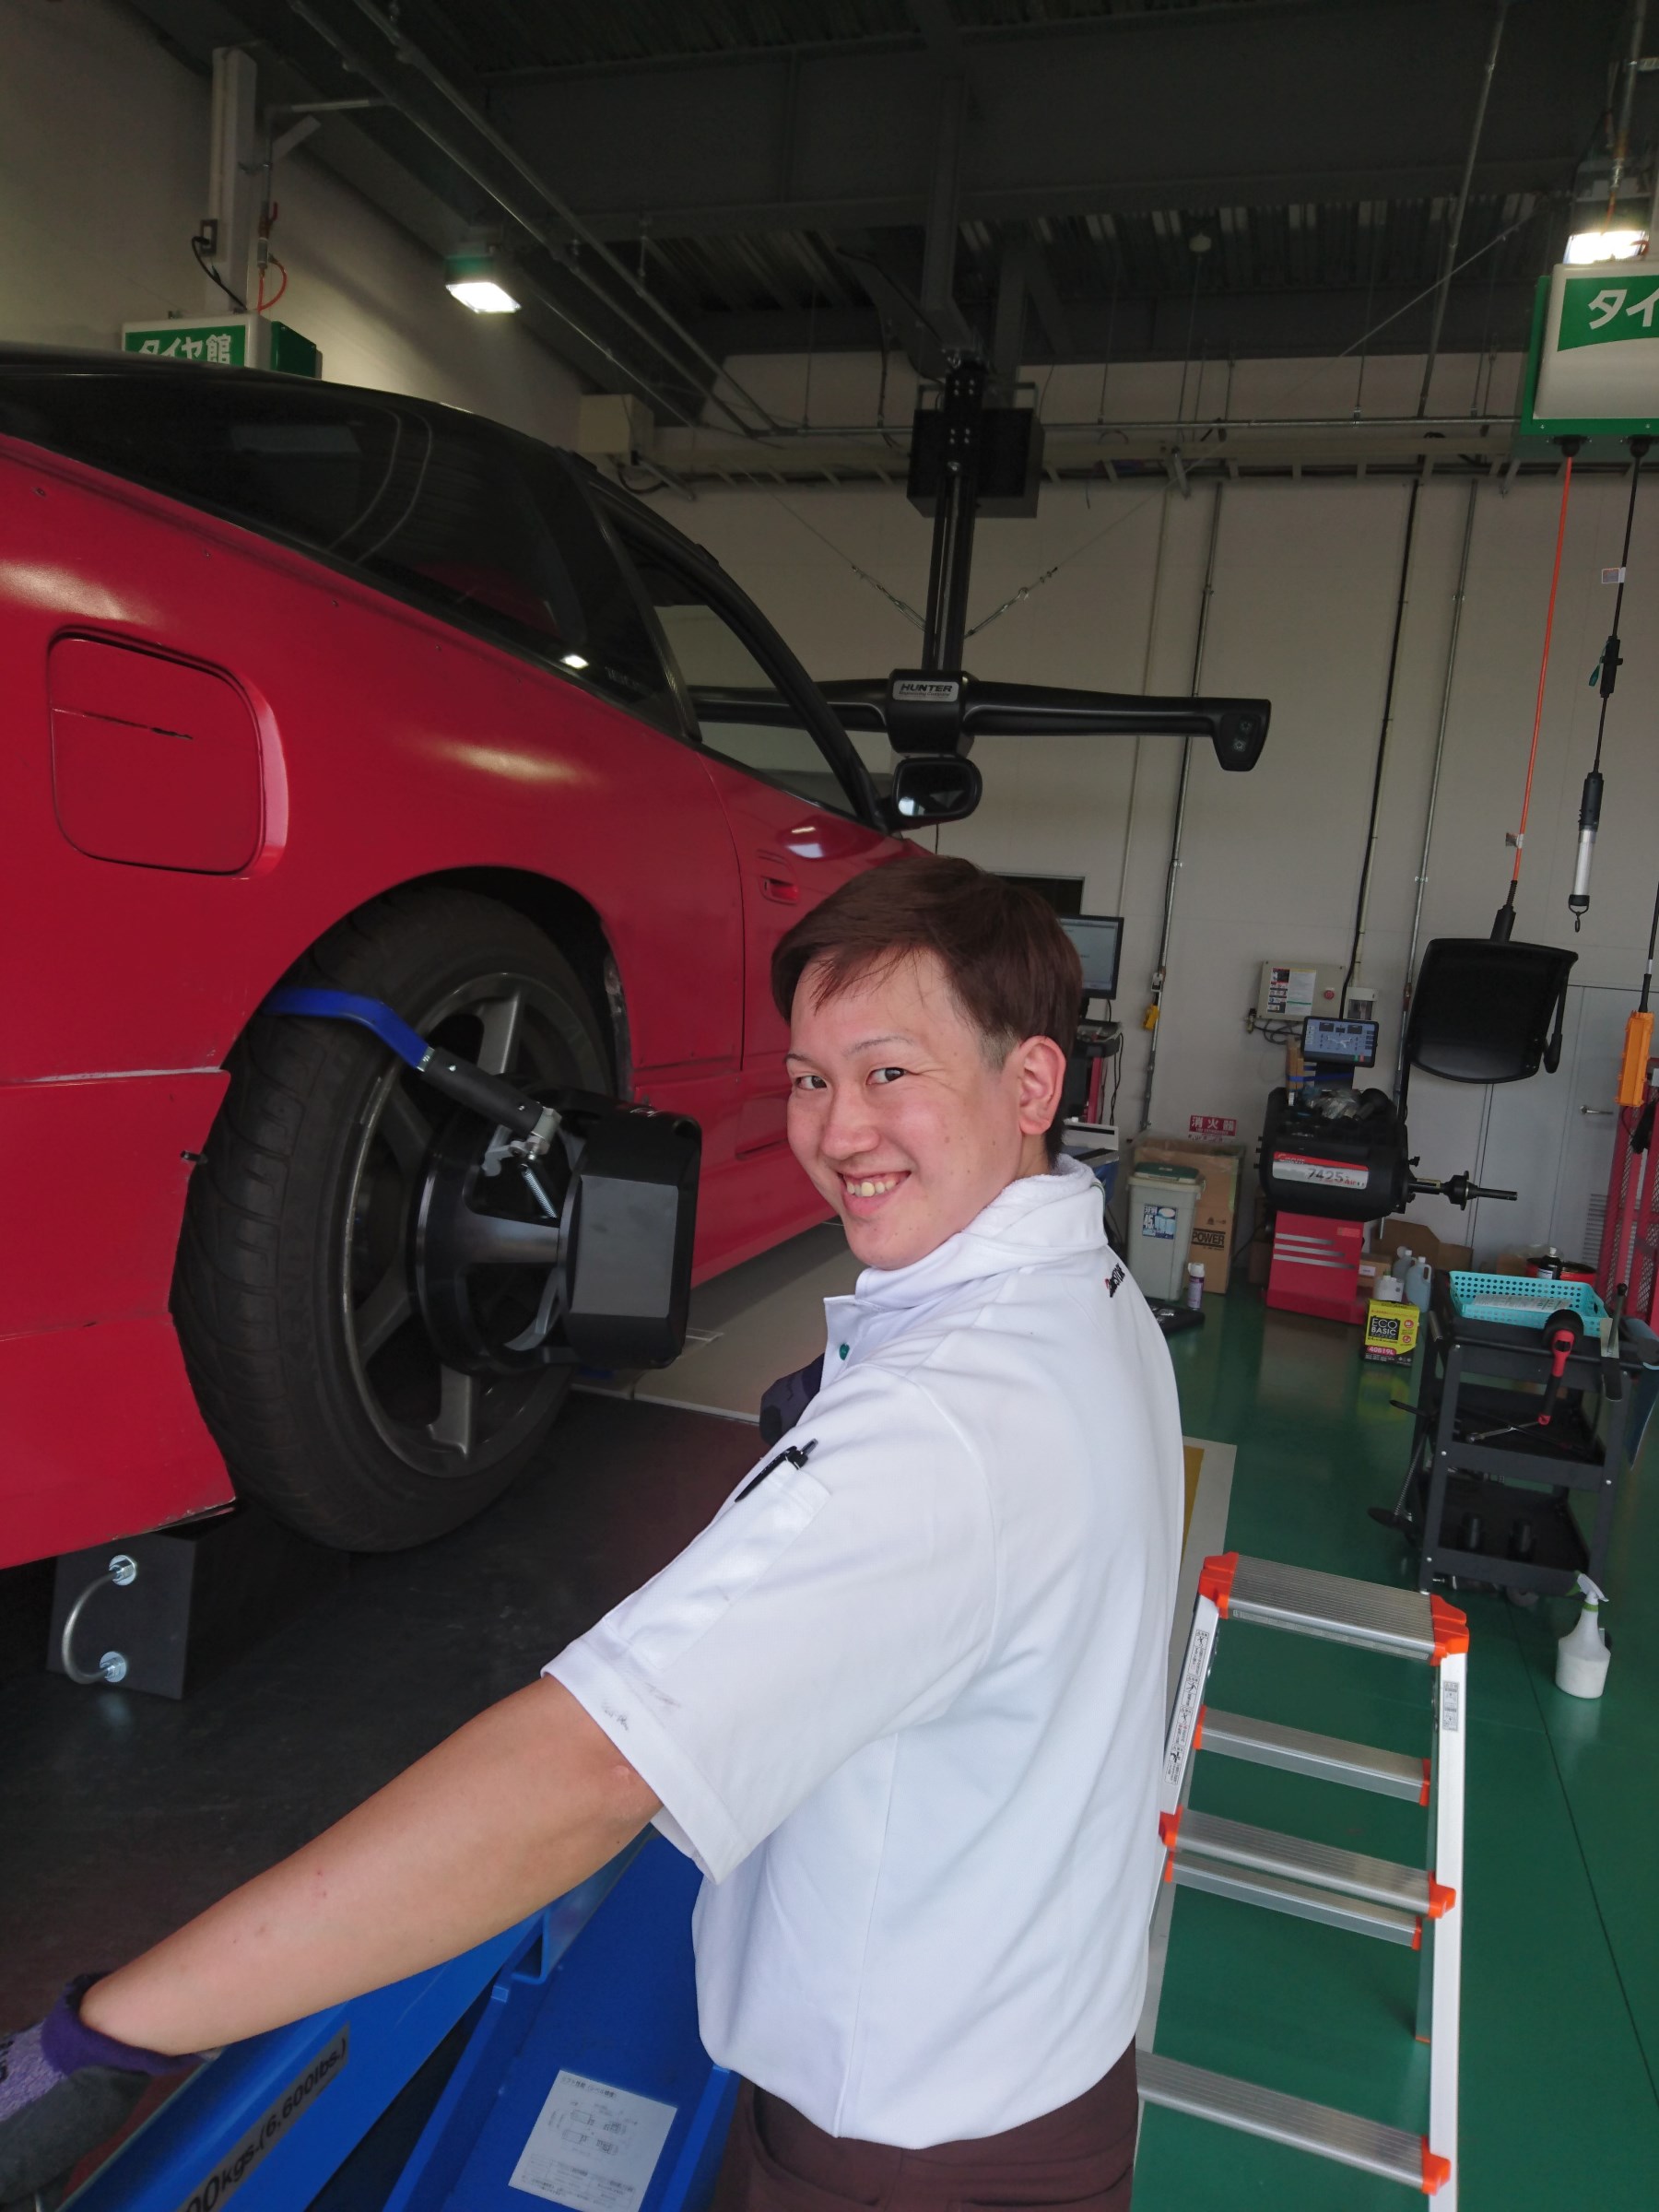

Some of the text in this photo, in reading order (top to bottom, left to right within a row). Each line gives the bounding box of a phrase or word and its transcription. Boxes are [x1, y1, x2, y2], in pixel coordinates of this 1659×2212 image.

[1588, 288, 1659, 330] タイ
[138, 334, 231, 364] タイヤ館
[900, 683, 953, 692] HUNTER
[1307, 1168, 1344, 1182] 7425
[1192, 1231, 1226, 1245] POWER
[1371, 1318, 1398, 1329] ECO
[1371, 1327, 1397, 1336] BASIC
